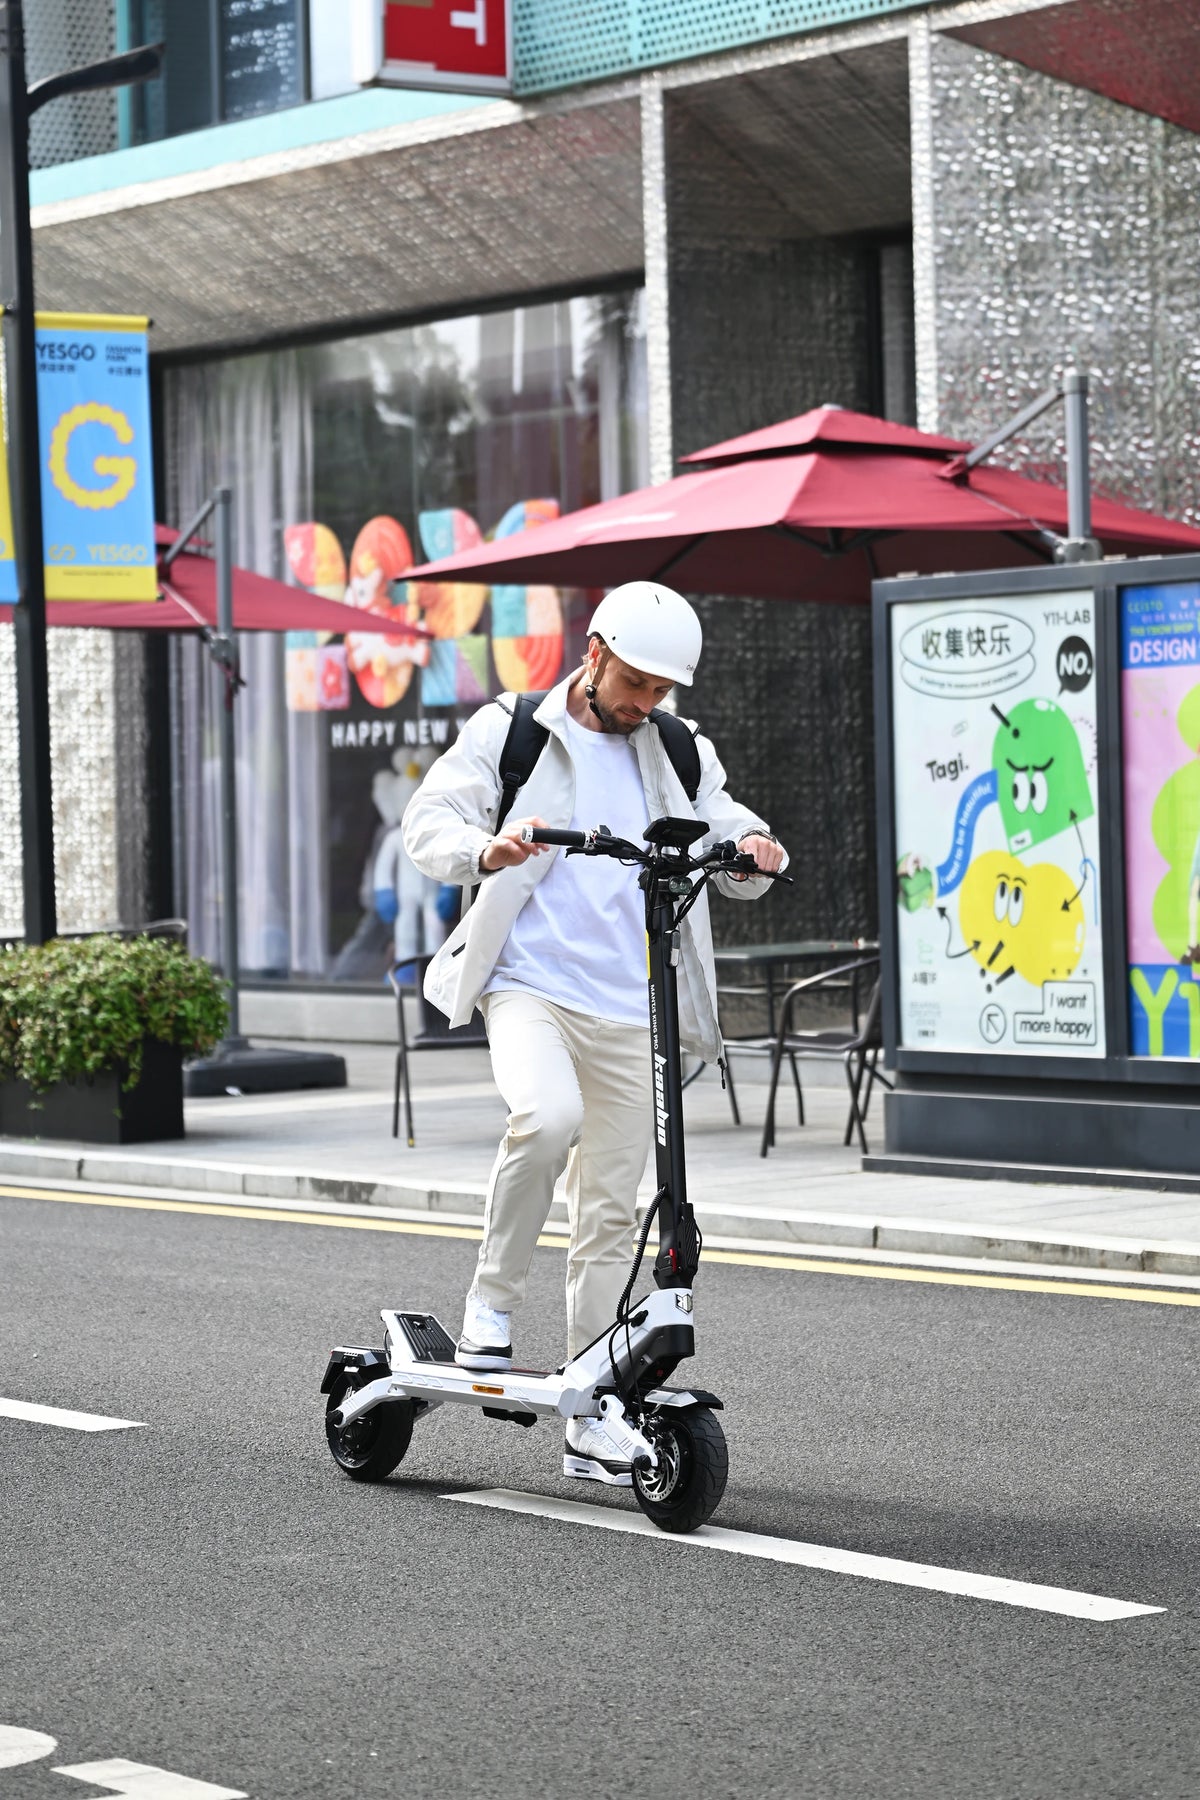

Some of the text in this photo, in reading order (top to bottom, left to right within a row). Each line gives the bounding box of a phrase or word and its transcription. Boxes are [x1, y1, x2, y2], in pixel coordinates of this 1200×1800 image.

[35, 344, 96, 361] YESGO
[48, 402, 137, 509] G
[87, 543, 148, 562] YESGO
[921, 624, 1012, 660] 收集快乐
[1129, 637, 1197, 664] DESIGN
[1059, 651, 1092, 676] NO.
[331, 720, 396, 748] HAPPY
[403, 718, 450, 746] NEW
[926, 752, 970, 782] Tagi.
[1057, 994, 1087, 1009] want
[1020, 1017, 1092, 1038] more happy
[654, 1052, 670, 1147] kaabo
